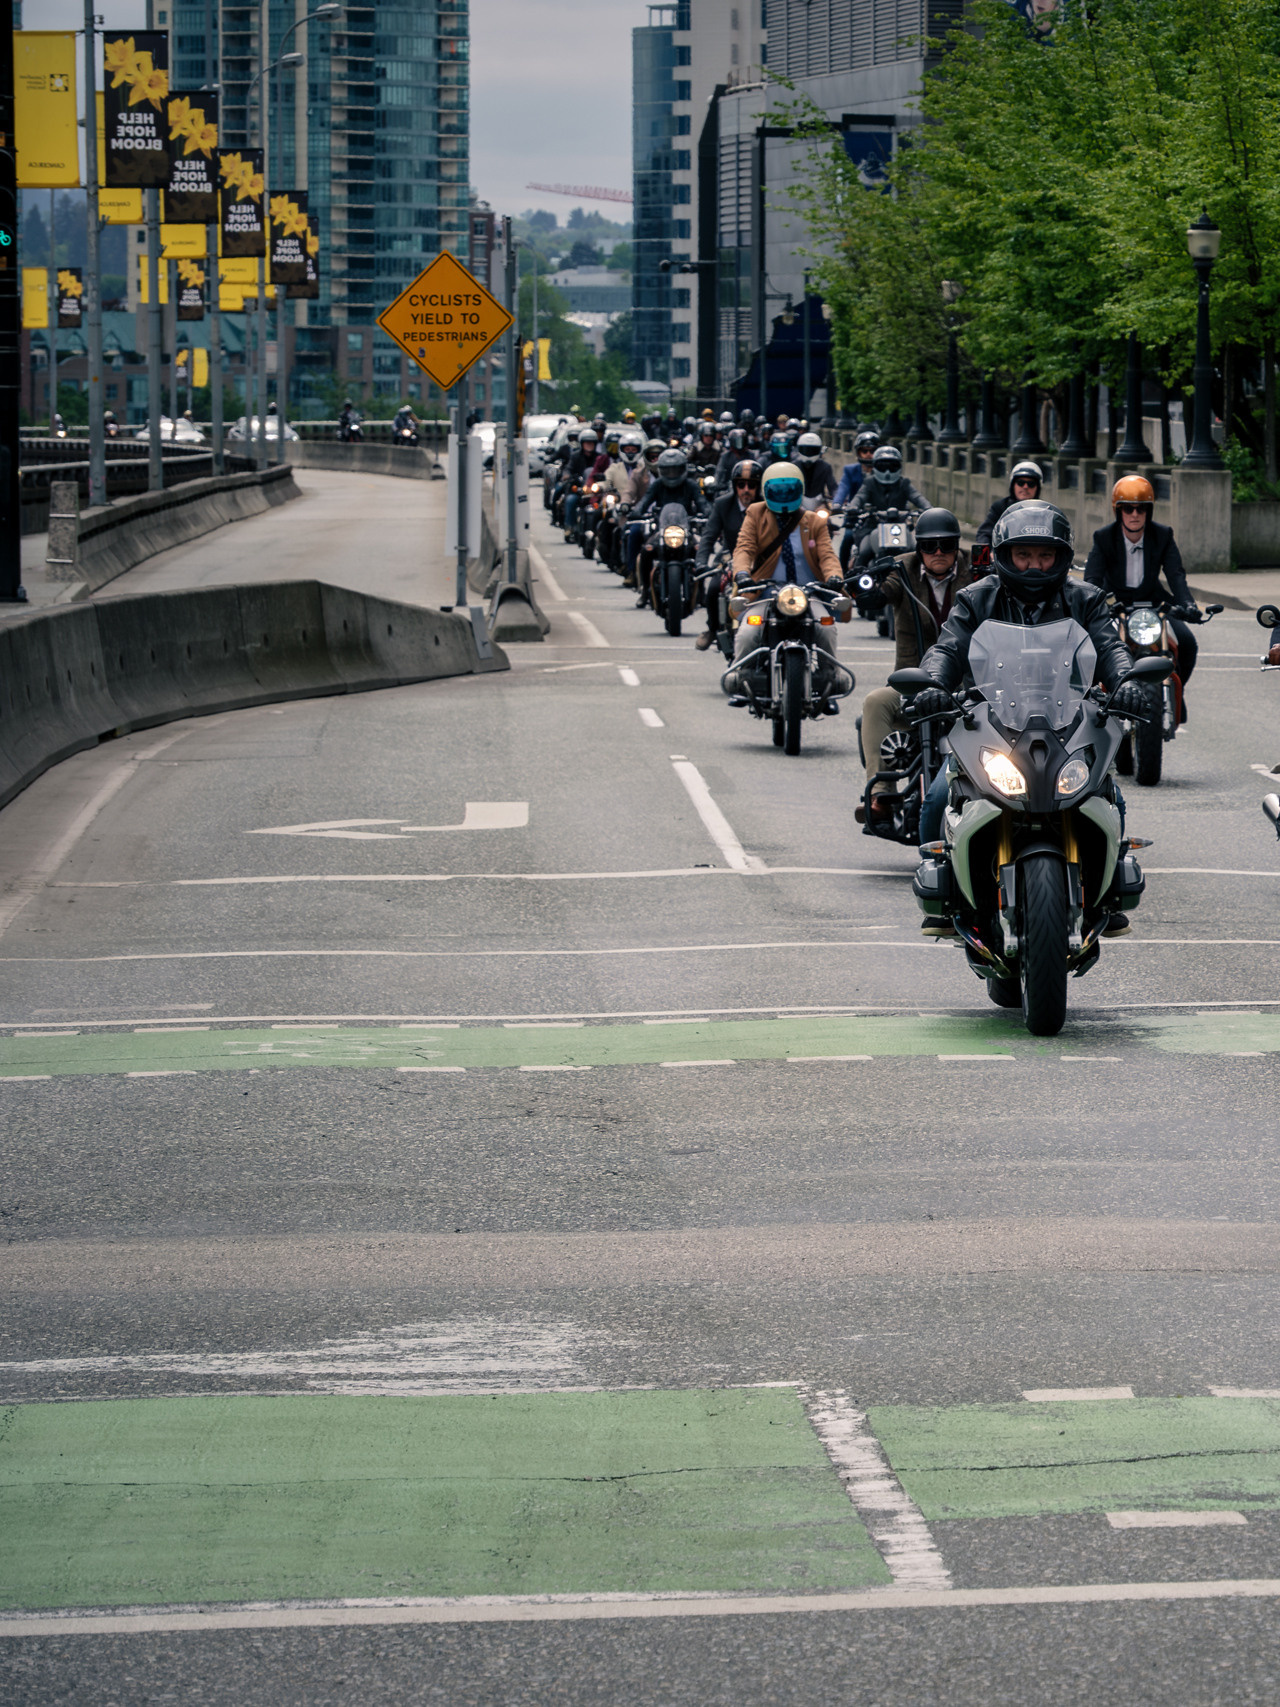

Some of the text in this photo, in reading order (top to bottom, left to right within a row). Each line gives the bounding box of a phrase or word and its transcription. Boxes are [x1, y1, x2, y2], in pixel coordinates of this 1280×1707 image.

[409, 294, 482, 306] CYCLISTS
[411, 312, 480, 325] YIELD TO
[403, 331, 488, 342] PEDESTRIANS
